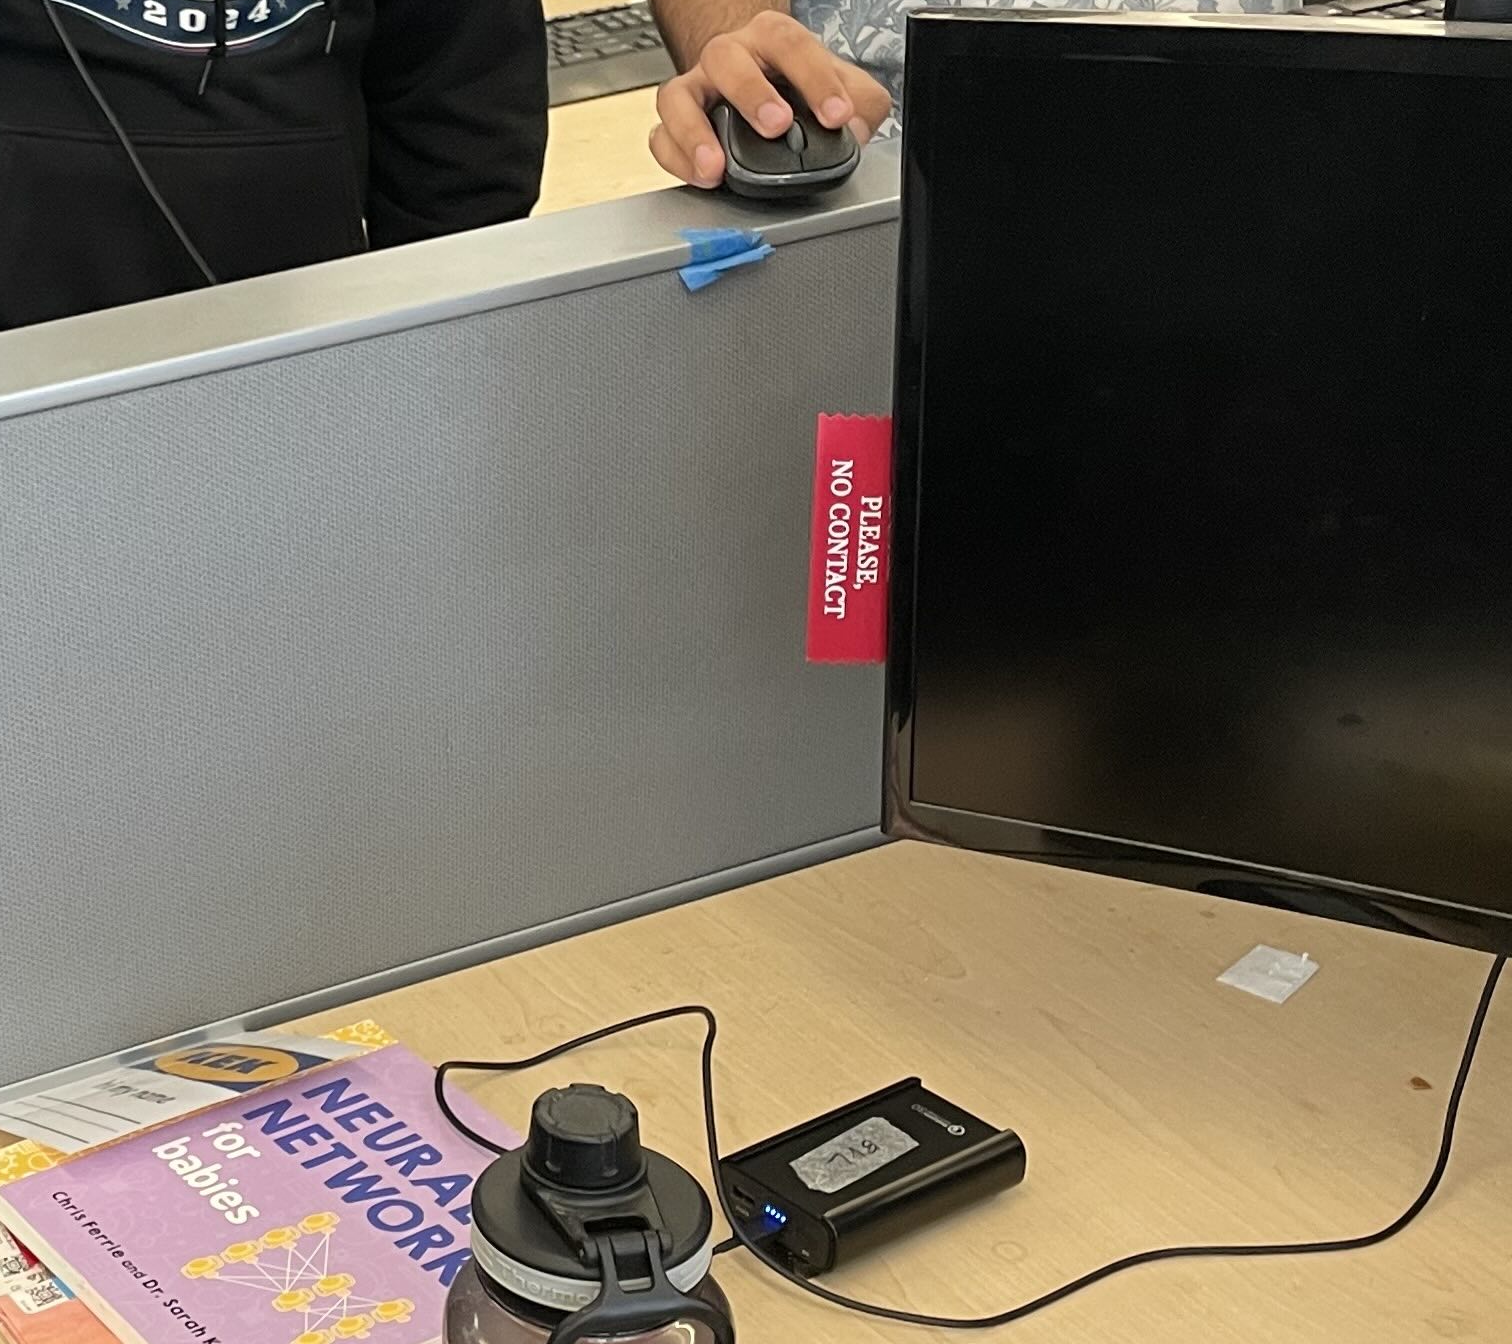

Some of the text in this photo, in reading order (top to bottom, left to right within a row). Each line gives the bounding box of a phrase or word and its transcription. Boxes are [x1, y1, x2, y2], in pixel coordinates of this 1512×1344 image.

[824, 459, 854, 620] NO CONTACT
[853, 495, 883, 590] PLEASE,
[152, 1136, 260, 1227] babies
[202, 1119, 262, 1161] for
[52, 1191, 87, 1222] Chris
[82, 1220, 125, 1259] Ferrie
[122, 1259, 148, 1280] and
[143, 1278, 164, 1299] Dr.
[164, 1298, 207, 1338] Sarah
[495, 1257, 601, 1303] Thermo
